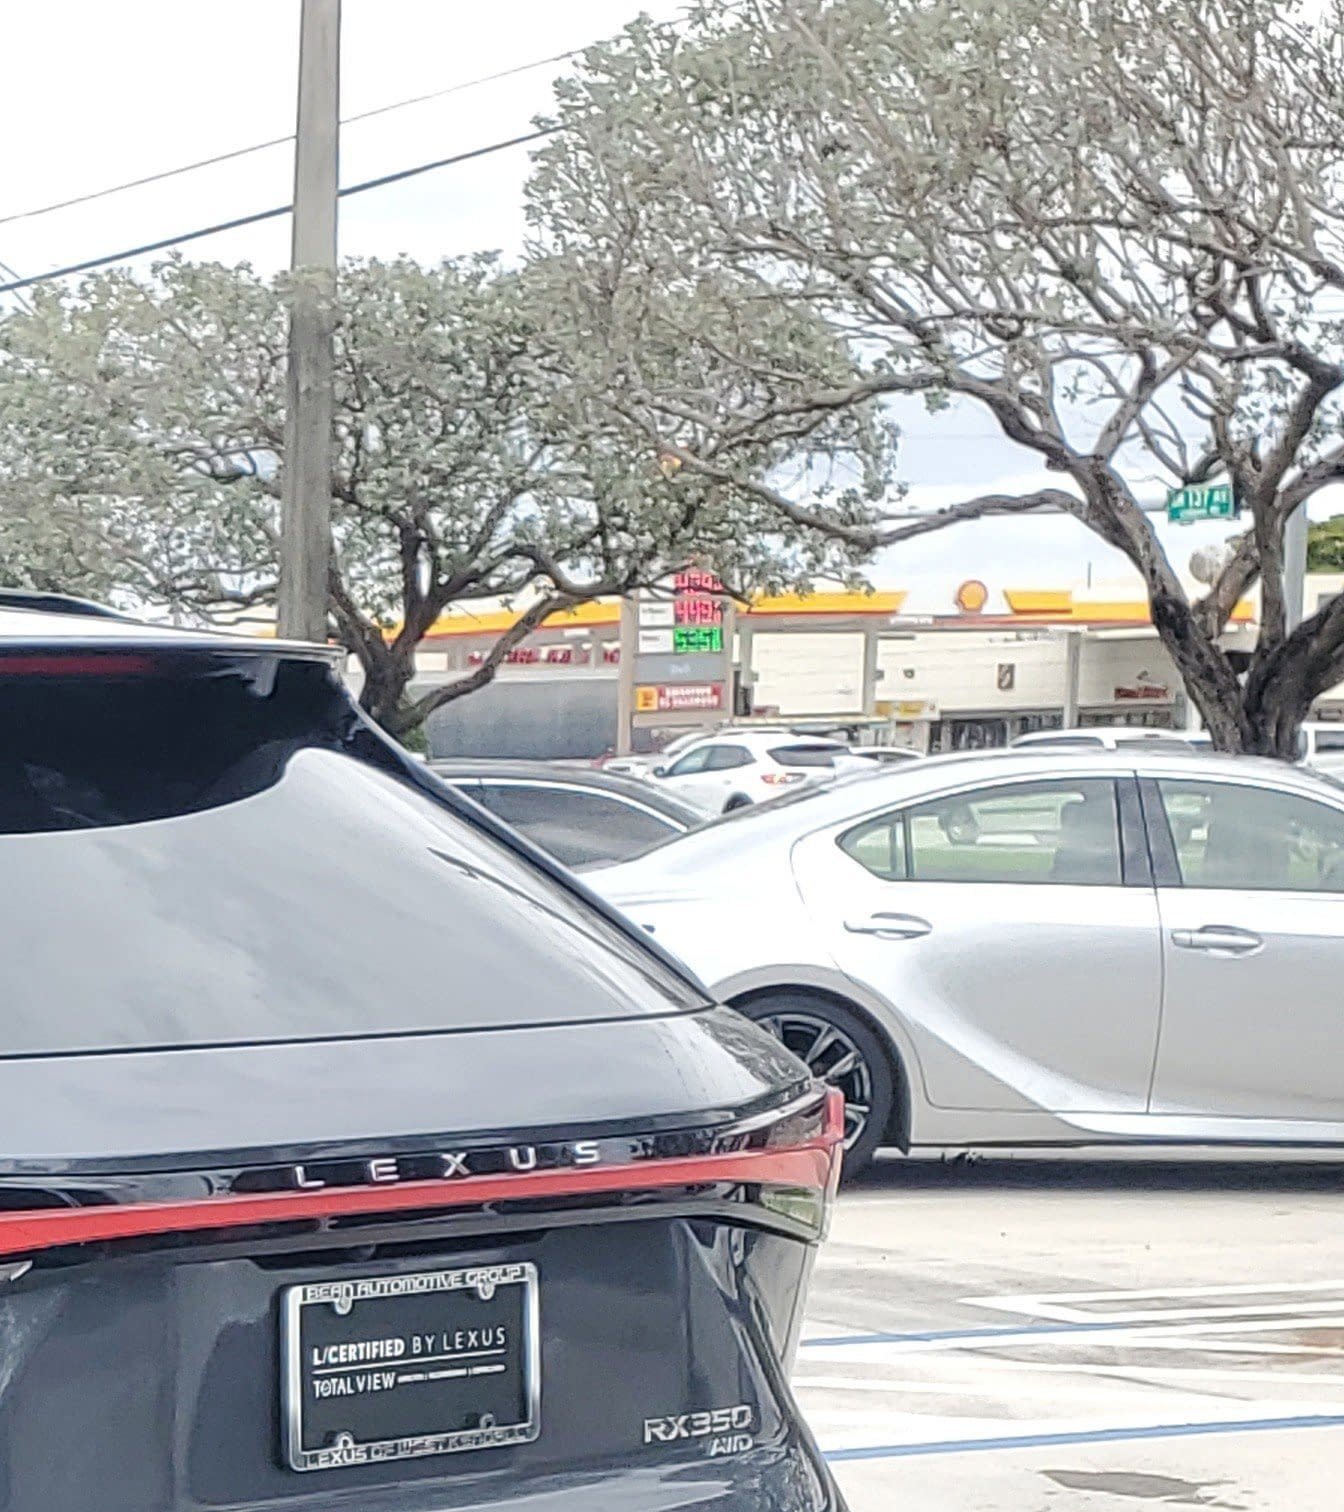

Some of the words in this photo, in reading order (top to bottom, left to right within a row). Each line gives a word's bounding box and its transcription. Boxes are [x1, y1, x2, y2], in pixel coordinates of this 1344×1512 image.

[295, 1140, 601, 1188] LEXUS
[358, 1272, 462, 1298] AUTOMOTIVE
[465, 1266, 522, 1285] GROUP
[313, 1338, 406, 1366] L/CERTIFIED
[412, 1334, 436, 1354] BY
[442, 1326, 506, 1352] LEXUS
[307, 1447, 368, 1468] LEXUS
